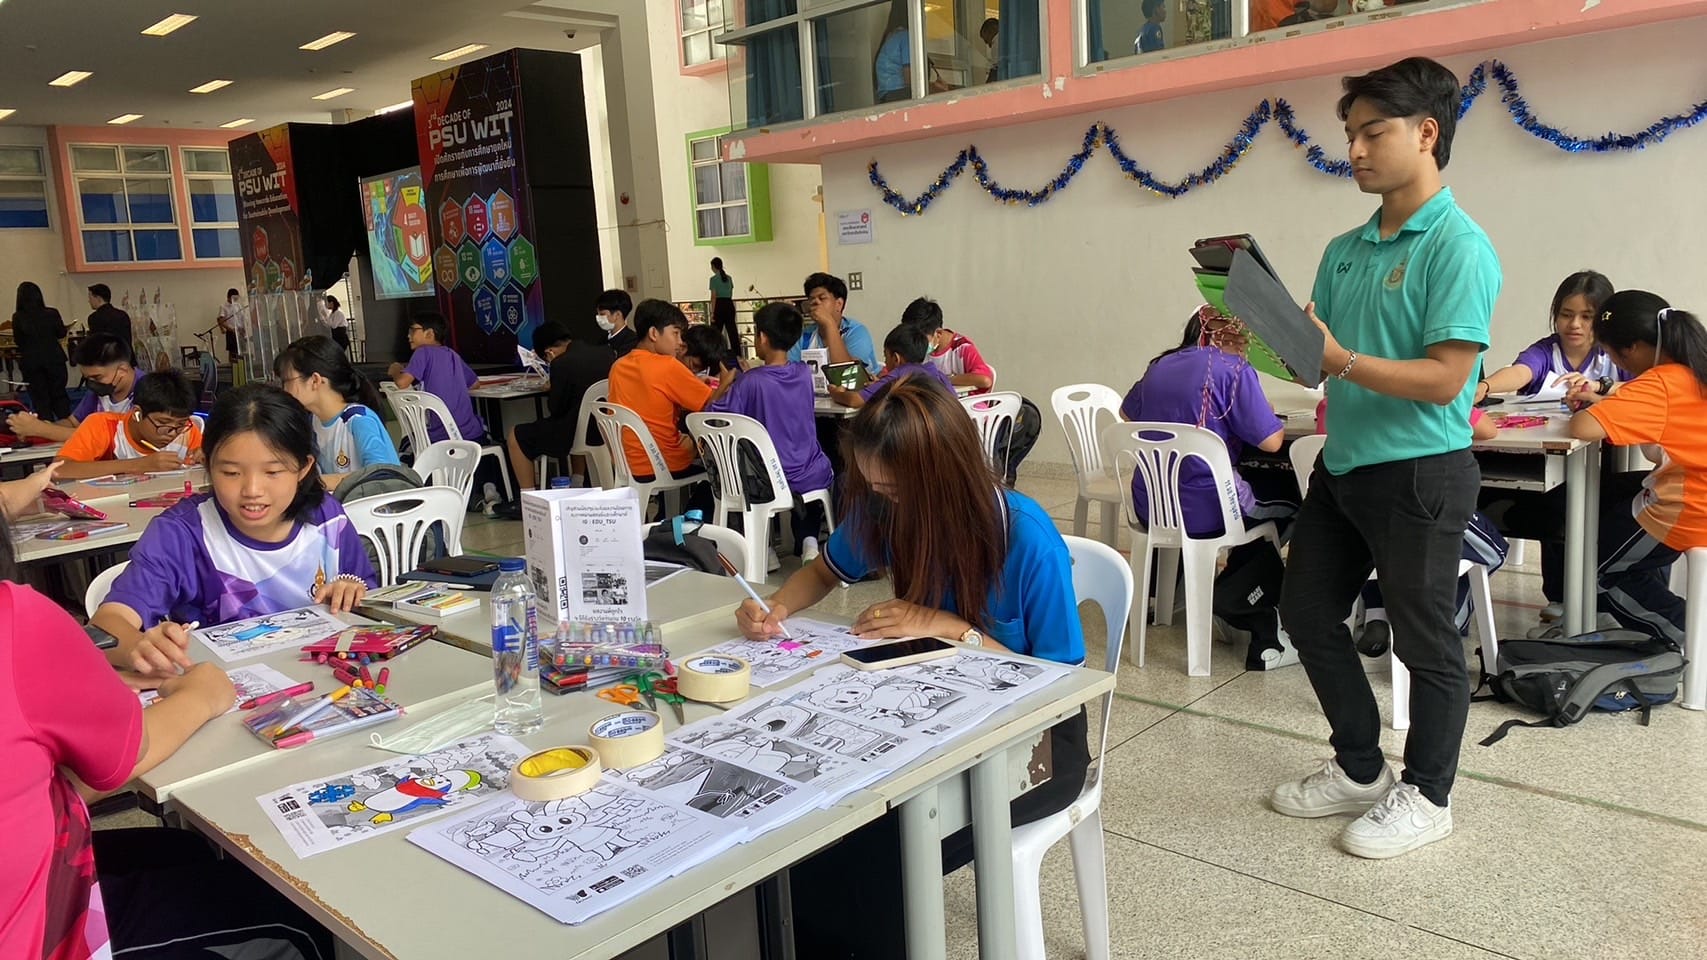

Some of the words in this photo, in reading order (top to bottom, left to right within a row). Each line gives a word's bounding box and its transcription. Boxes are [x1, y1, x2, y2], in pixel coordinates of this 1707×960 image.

[496, 98, 512, 112] 2024
[437, 111, 462, 126] DECADE
[462, 108, 472, 120] OF
[429, 121, 468, 151] PSU
[470, 110, 513, 141] WIT
[239, 176, 261, 198] PSU
[262, 170, 287, 191] WIT
